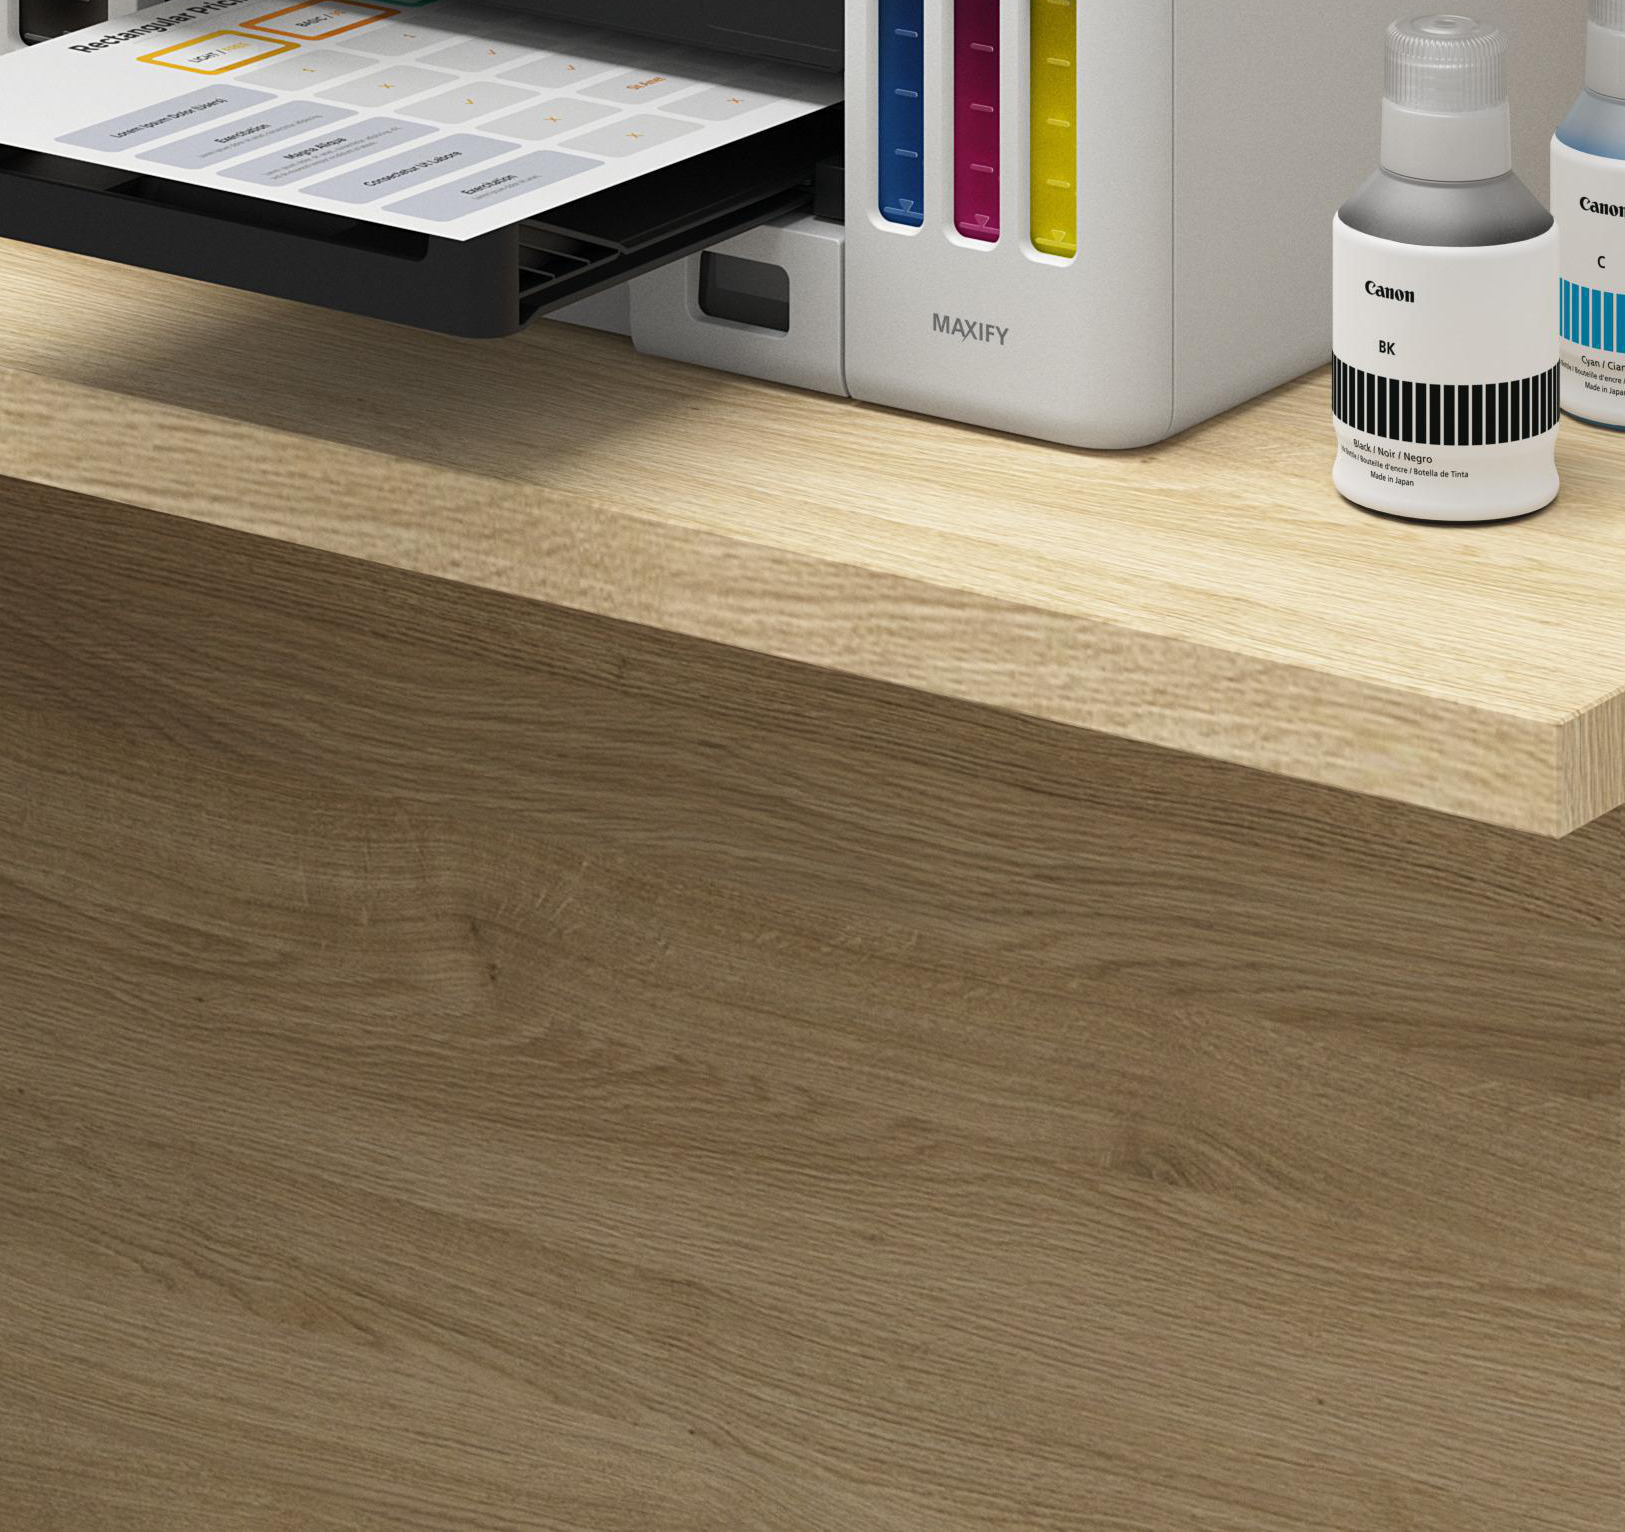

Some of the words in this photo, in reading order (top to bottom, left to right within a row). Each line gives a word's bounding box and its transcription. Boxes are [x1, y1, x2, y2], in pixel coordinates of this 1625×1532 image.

[68, 10, 197, 54] Rectangular
[110, 124, 141, 139] Lorem
[213, 123, 271, 145] Exercitation
[283, 145, 317, 161] Magna
[315, 137, 348, 151] Aliqua
[362, 165, 417, 188] Consectetur
[431, 150, 463, 164] Labore
[460, 172, 519, 197] Exercitation
[1597, 255, 1606, 269] C
[1364, 280, 1415, 303] Canon
[932, 312, 1009, 347] MAXIFY
[1378, 340, 1396, 356] BK
[1581, 355, 1601, 370] Cyan
[1584, 381, 1600, 392] Made
[1601, 385, 1608, 394] in
[1353, 439, 1371, 453] Black
[1377, 446, 1395, 460] Noir
[1403, 451, 1433, 466] Negro
[1370, 471, 1386, 481] Made
[1387, 475, 1394, 484] in
[1395, 476, 1415, 487] Japan
